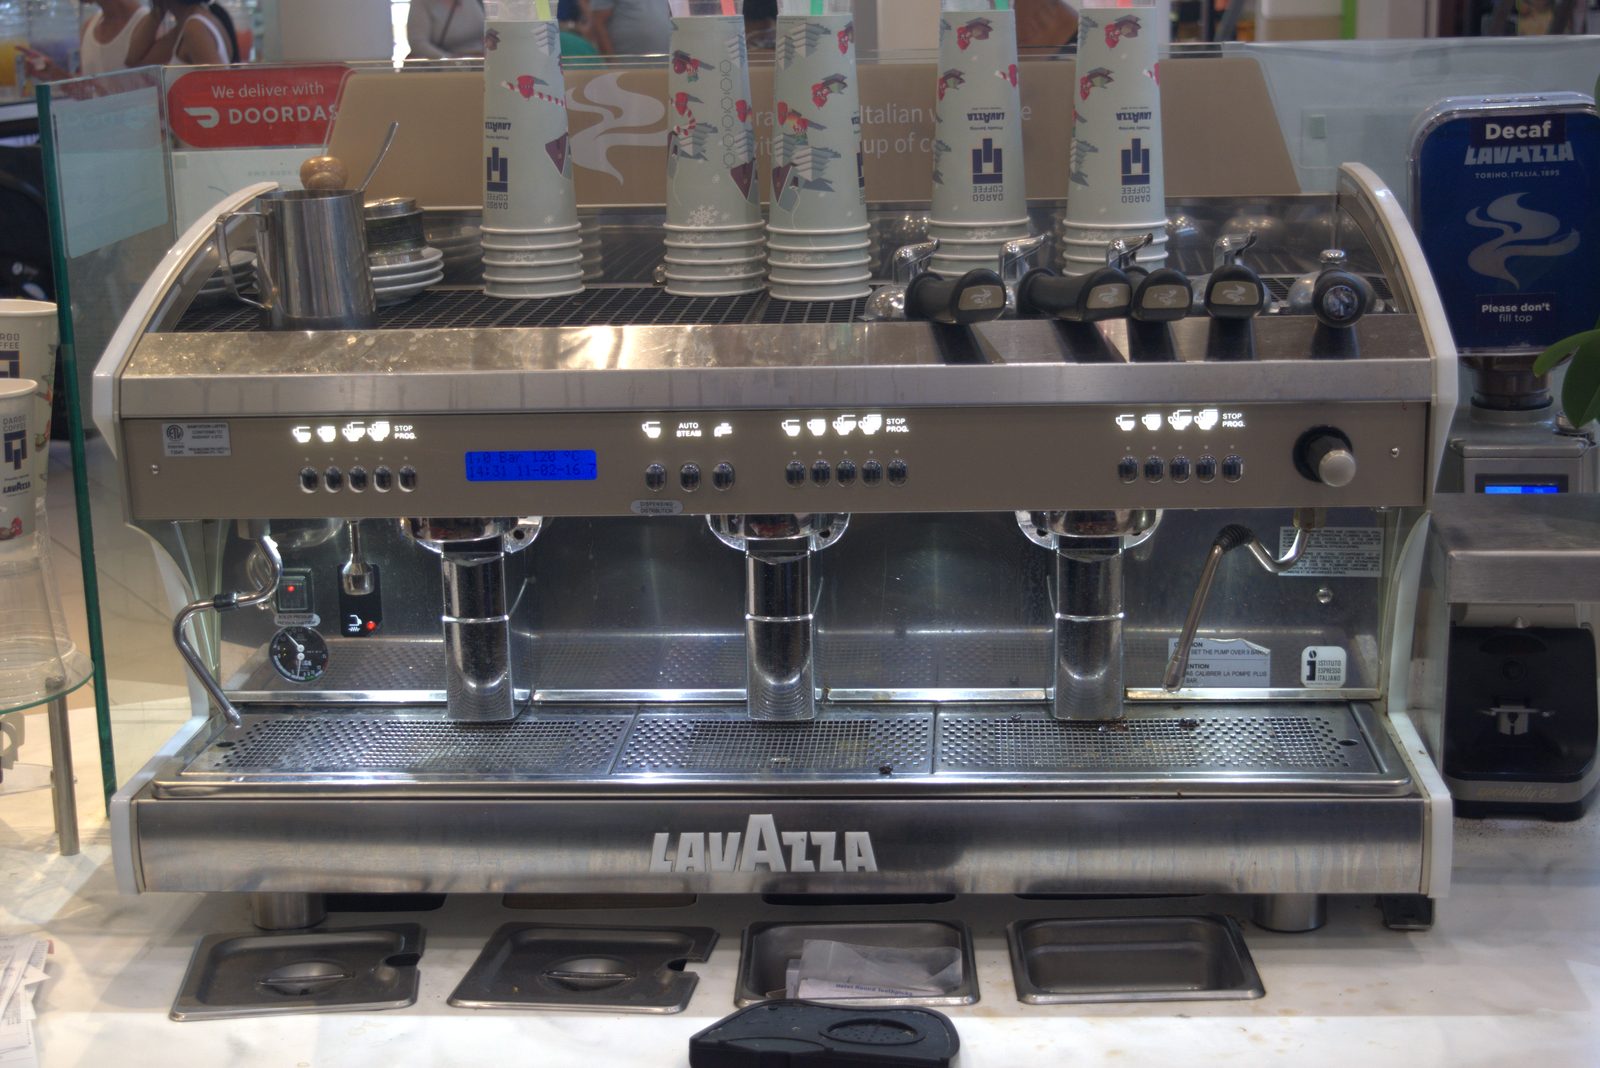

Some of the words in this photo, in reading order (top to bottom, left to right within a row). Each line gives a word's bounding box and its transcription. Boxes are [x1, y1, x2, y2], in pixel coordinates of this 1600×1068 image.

[211, 85, 234, 99] We
[239, 83, 288, 98] deliver
[292, 82, 325, 96] with
[860, 103, 922, 124] Italian
[967, 111, 1005, 123] LAVAZZA
[1116, 111, 1152, 123] LAVAZZA
[1485, 120, 1552, 140] Decaf
[863, 138, 888, 160] up
[895, 132, 918, 153] of
[1464, 141, 1574, 165] LAVAZZA
[972, 185, 1004, 193] COFFEE
[1121, 186, 1151, 194] COFFEE
[1482, 304, 1518, 313] Please
[1520, 303, 1551, 312] don't
[1499, 313, 1512, 322] fill
[1514, 314, 1533, 323] top
[679, 422, 699, 430] AUTO
[500, 451, 520, 463] Bar
[533, 450, 556, 462] 120
[650, 814, 878, 873] LAVAZZA
